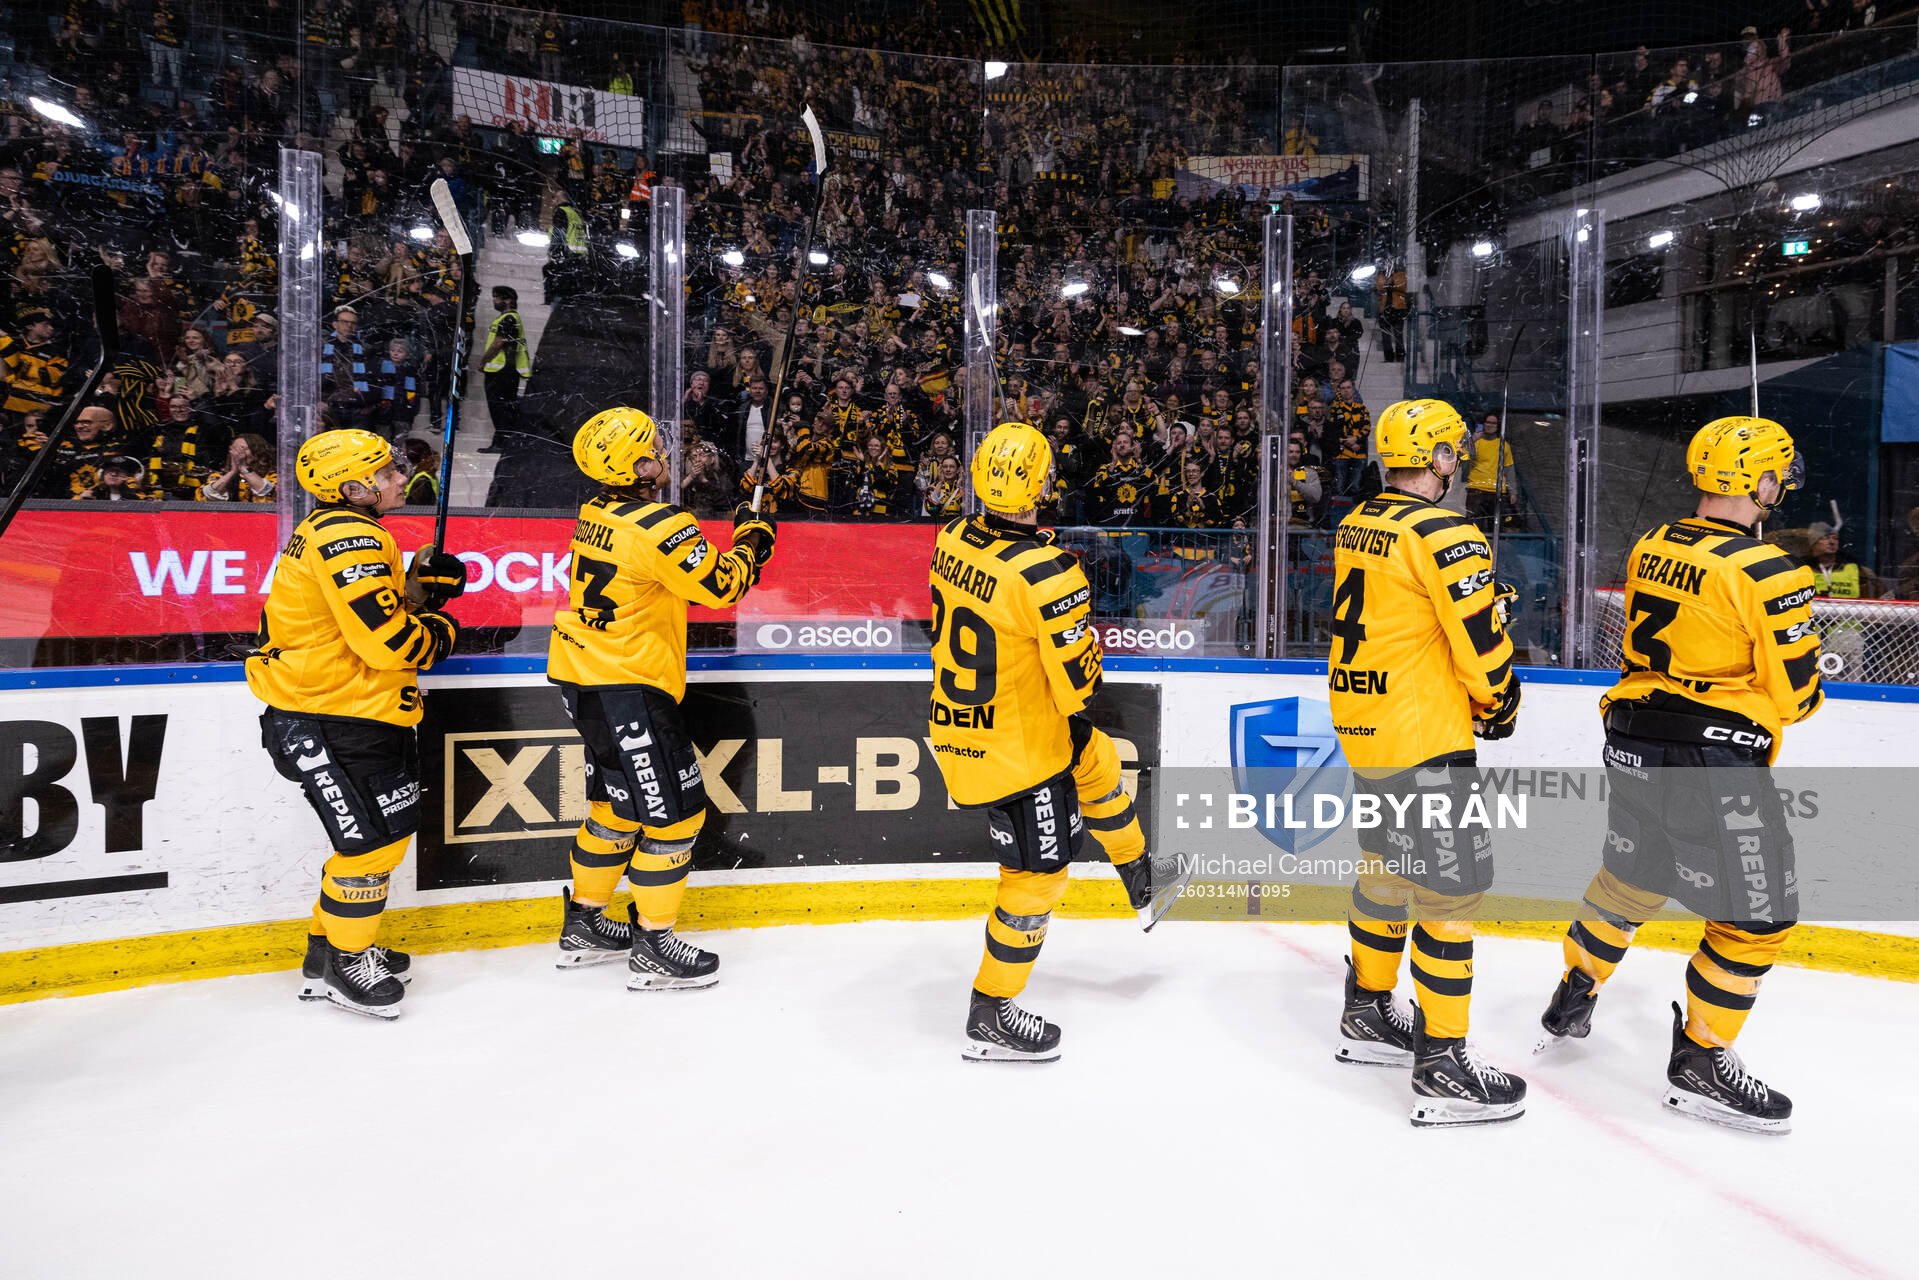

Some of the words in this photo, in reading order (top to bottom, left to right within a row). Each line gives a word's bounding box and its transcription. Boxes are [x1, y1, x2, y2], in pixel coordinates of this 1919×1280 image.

[1223, 158, 1309, 172] NORRLANDS
[1702, 451, 1709, 460] 3
[328, 538, 381, 554] HOLMEN
[666, 524, 699, 549] HOLMEN
[1670, 532, 1693, 542] CCM
[1445, 542, 1488, 562] HOLMEN
[129, 551, 246, 595] WE
[1637, 553, 1707, 596] GRAHN
[1333, 567, 1367, 664] 4
[798, 620, 893, 648] asedo
[931, 585, 998, 706] 9
[1105, 623, 1195, 650] asedo
[1702, 725, 1772, 749] CCM
[1607, 746, 1642, 768] BASTU
[0, 714, 168, 863] BY
[632, 753, 668, 820] REPAY
[1481, 767, 1586, 801] WHEN
[314, 771, 364, 840] REPAY
[1033, 787, 1059, 861] REPAY
[1737, 835, 1774, 924] REPAY
[569, 934, 596, 948] CCM
[636, 954, 672, 976] CCM
[978, 1022, 1013, 1049] CCM
[1354, 1017, 1385, 1041] CCM
[1433, 1071, 1480, 1103] CCM
[1684, 1068, 1730, 1105] CCM
